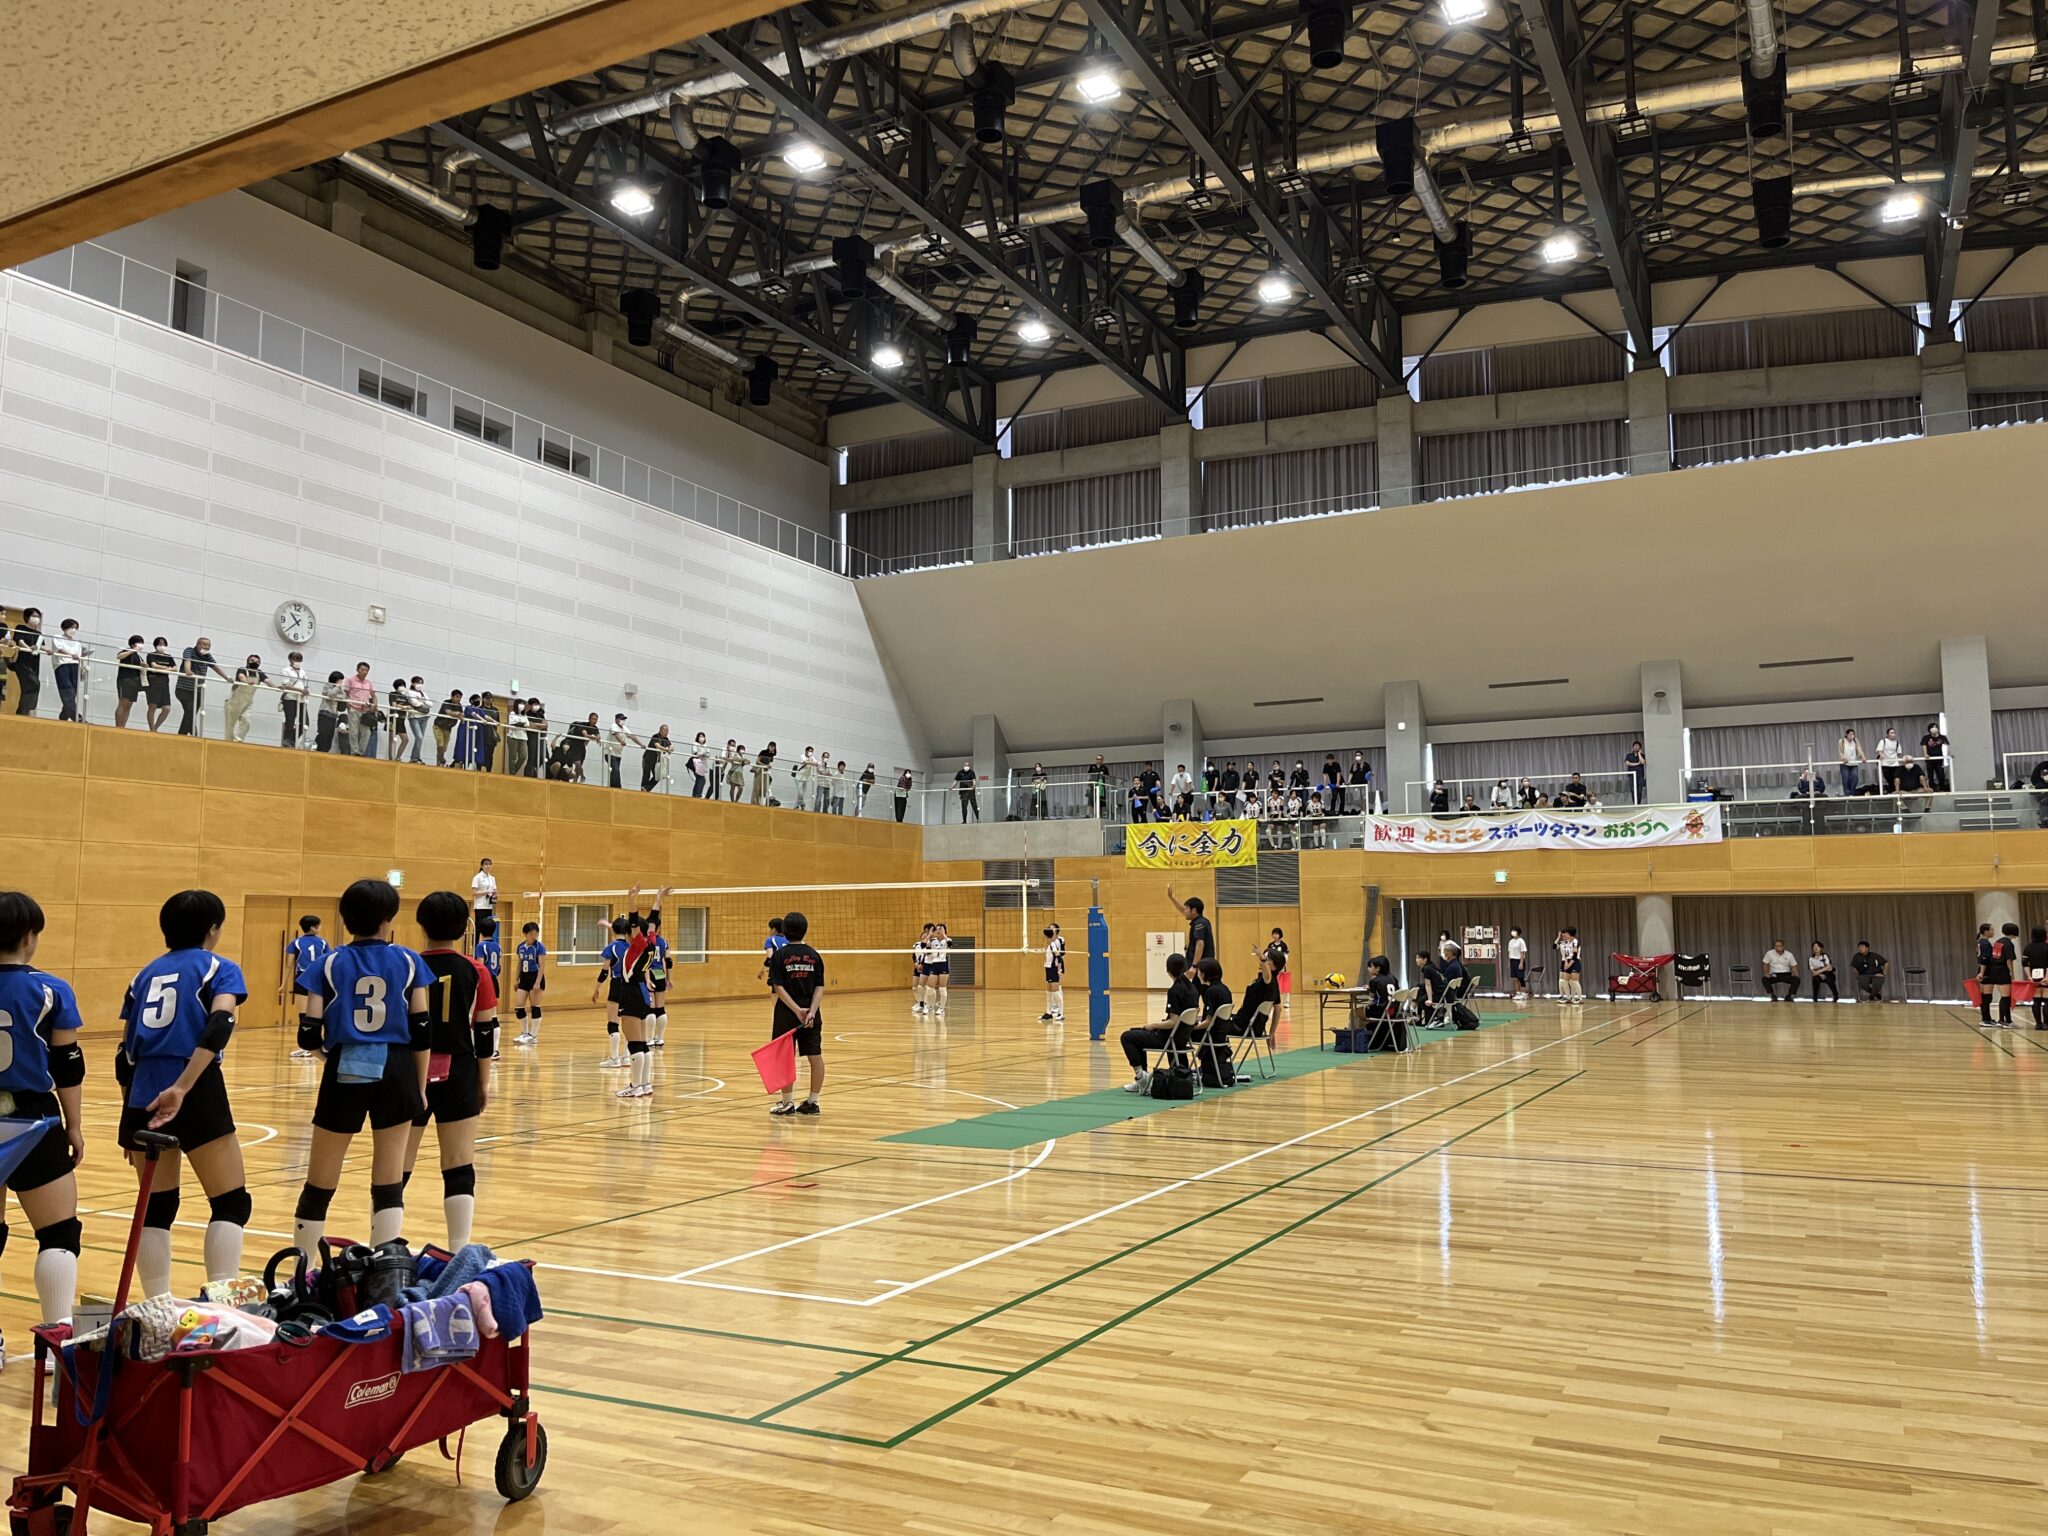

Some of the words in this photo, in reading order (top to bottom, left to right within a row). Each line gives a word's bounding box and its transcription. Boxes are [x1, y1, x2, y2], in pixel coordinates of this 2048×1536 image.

[294, 604, 301, 612] 12
[308, 621, 313, 629] 3
[294, 632, 299, 640] 6
[1374, 823, 1415, 843] 歓迎
[1423, 827, 1484, 844] ようこそ
[1488, 821, 1598, 841] スポーツタウン
[1603, 818, 1670, 839] おおづへ
[1137, 827, 1243, 859] 今に全力
[307, 944, 316, 962] 1
[490, 951, 498, 970] 9
[653, 945, 661, 962] 4
[522, 960, 529, 973] 8
[142, 972, 179, 1029] 5
[353, 975, 387, 1033] 3
[350, 1381, 389, 1401] Coleman
